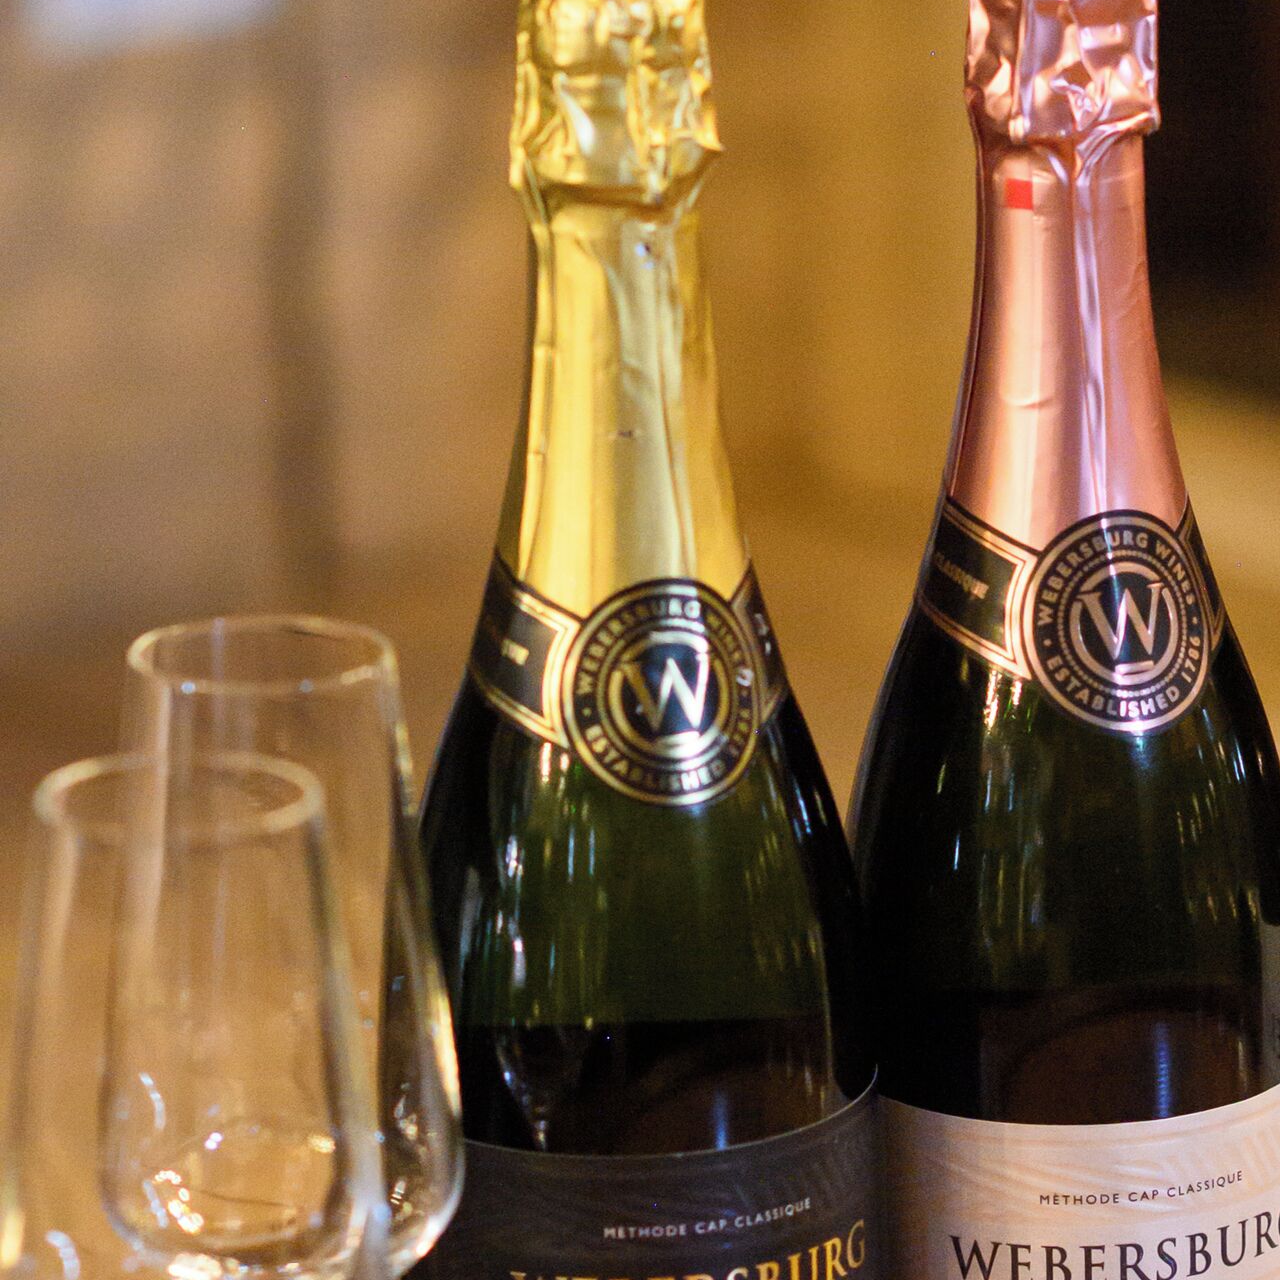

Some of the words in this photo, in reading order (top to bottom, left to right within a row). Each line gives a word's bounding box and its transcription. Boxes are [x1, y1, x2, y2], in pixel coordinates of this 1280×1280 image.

[1047, 654, 1180, 718] ESTABLISHED
[1128, 1189, 1159, 1202] CAP
[1167, 1171, 1243, 1197] CLASSIQUE
[695, 1219, 727, 1234] CAP
[734, 1197, 811, 1228] CLASSIQUE
